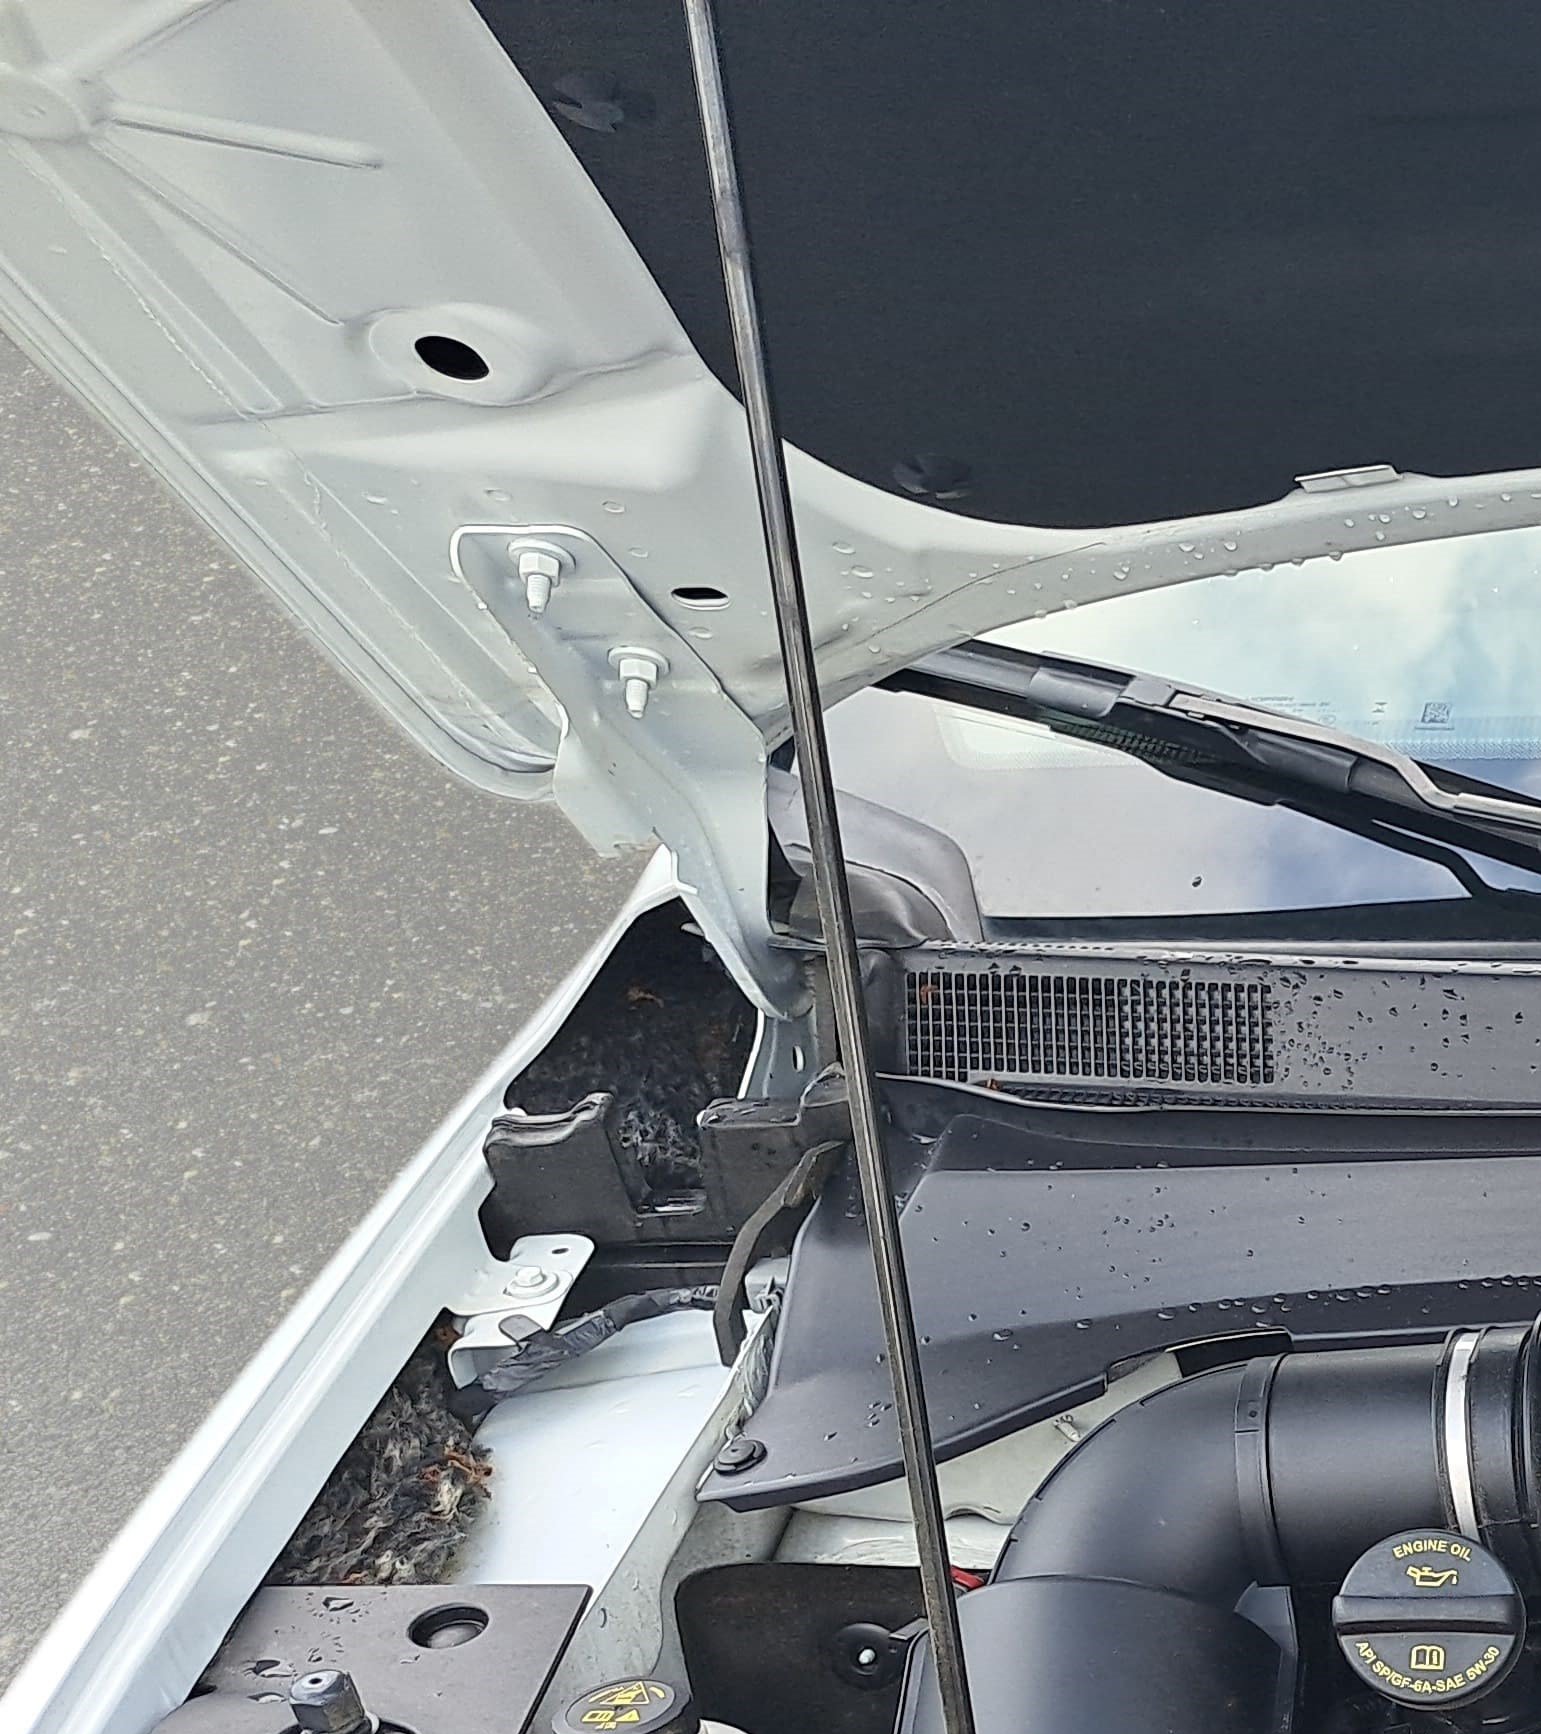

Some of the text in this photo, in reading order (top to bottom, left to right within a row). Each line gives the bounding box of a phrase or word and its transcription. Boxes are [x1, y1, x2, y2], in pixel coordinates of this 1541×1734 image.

[1392, 1539, 1473, 1562] ENGINE OIL
[1355, 1641, 1375, 1664] API
[1466, 1646, 1500, 1681] 5W-30
